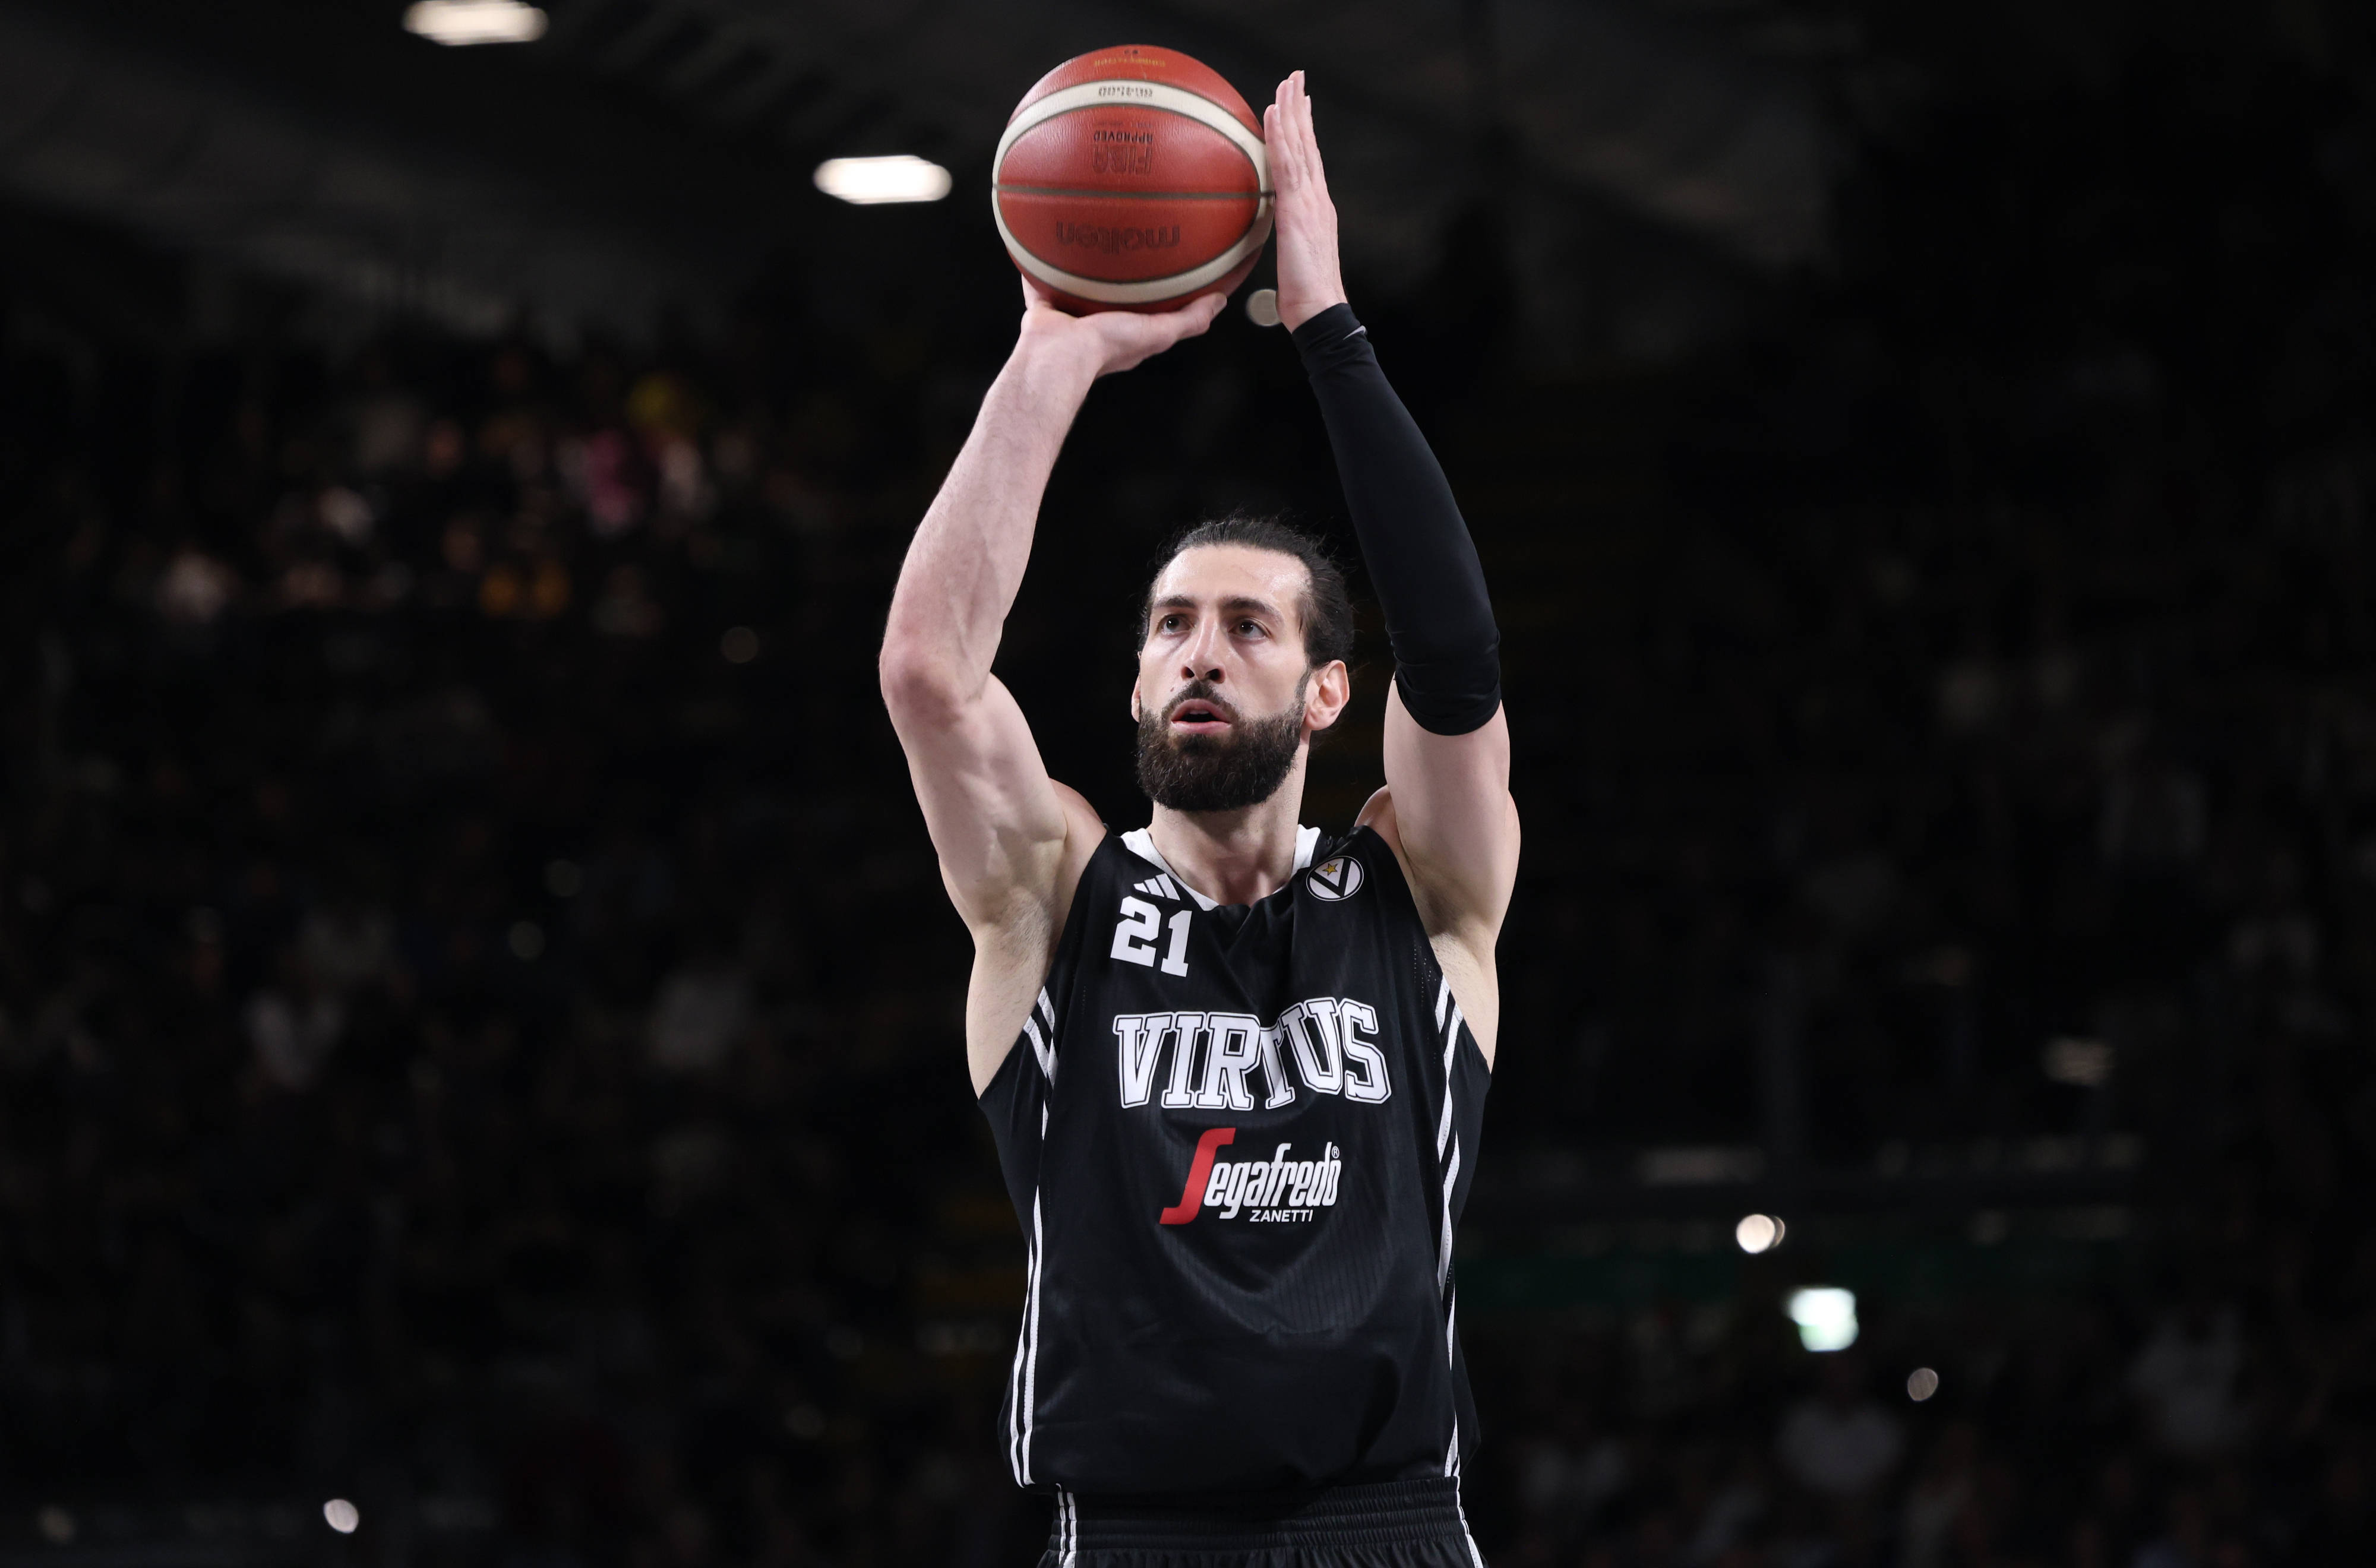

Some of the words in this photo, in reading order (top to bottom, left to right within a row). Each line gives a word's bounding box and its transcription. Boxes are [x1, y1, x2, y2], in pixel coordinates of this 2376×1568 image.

[1094, 131, 1153, 143] APPROVED
[1092, 144, 1152, 175] FIBA
[1056, 221, 1181, 254] molten
[1110, 895, 1192, 978] 21
[1112, 996, 1392, 1111] VIRTUS
[1249, 1209, 1313, 1222] ZANETTI
